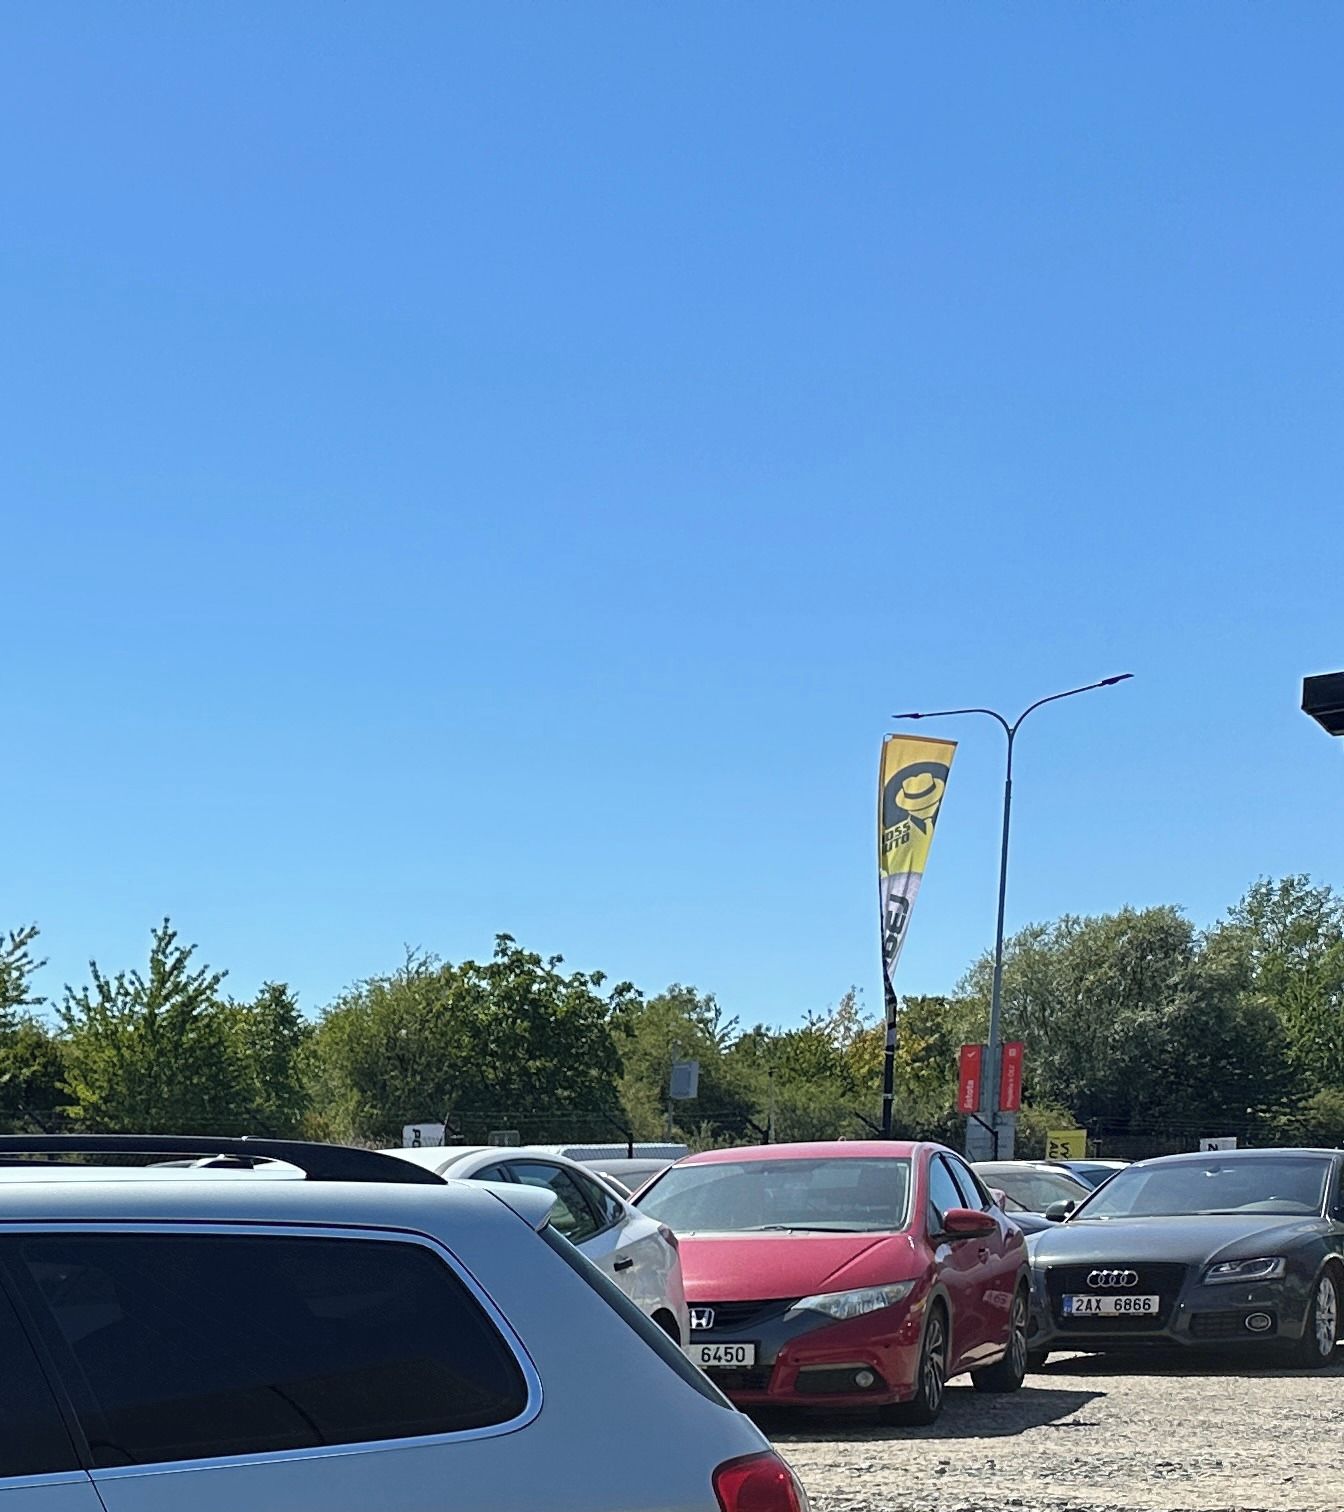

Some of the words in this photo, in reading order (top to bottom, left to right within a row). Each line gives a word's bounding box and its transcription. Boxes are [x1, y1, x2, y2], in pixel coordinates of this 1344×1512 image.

[882, 821, 911, 845] OSS
[882, 832, 910, 856] UTO
[1075, 1298, 1102, 1312] 2AX
[1114, 1297, 1152, 1311] 6866
[701, 1346, 746, 1363] 6450
